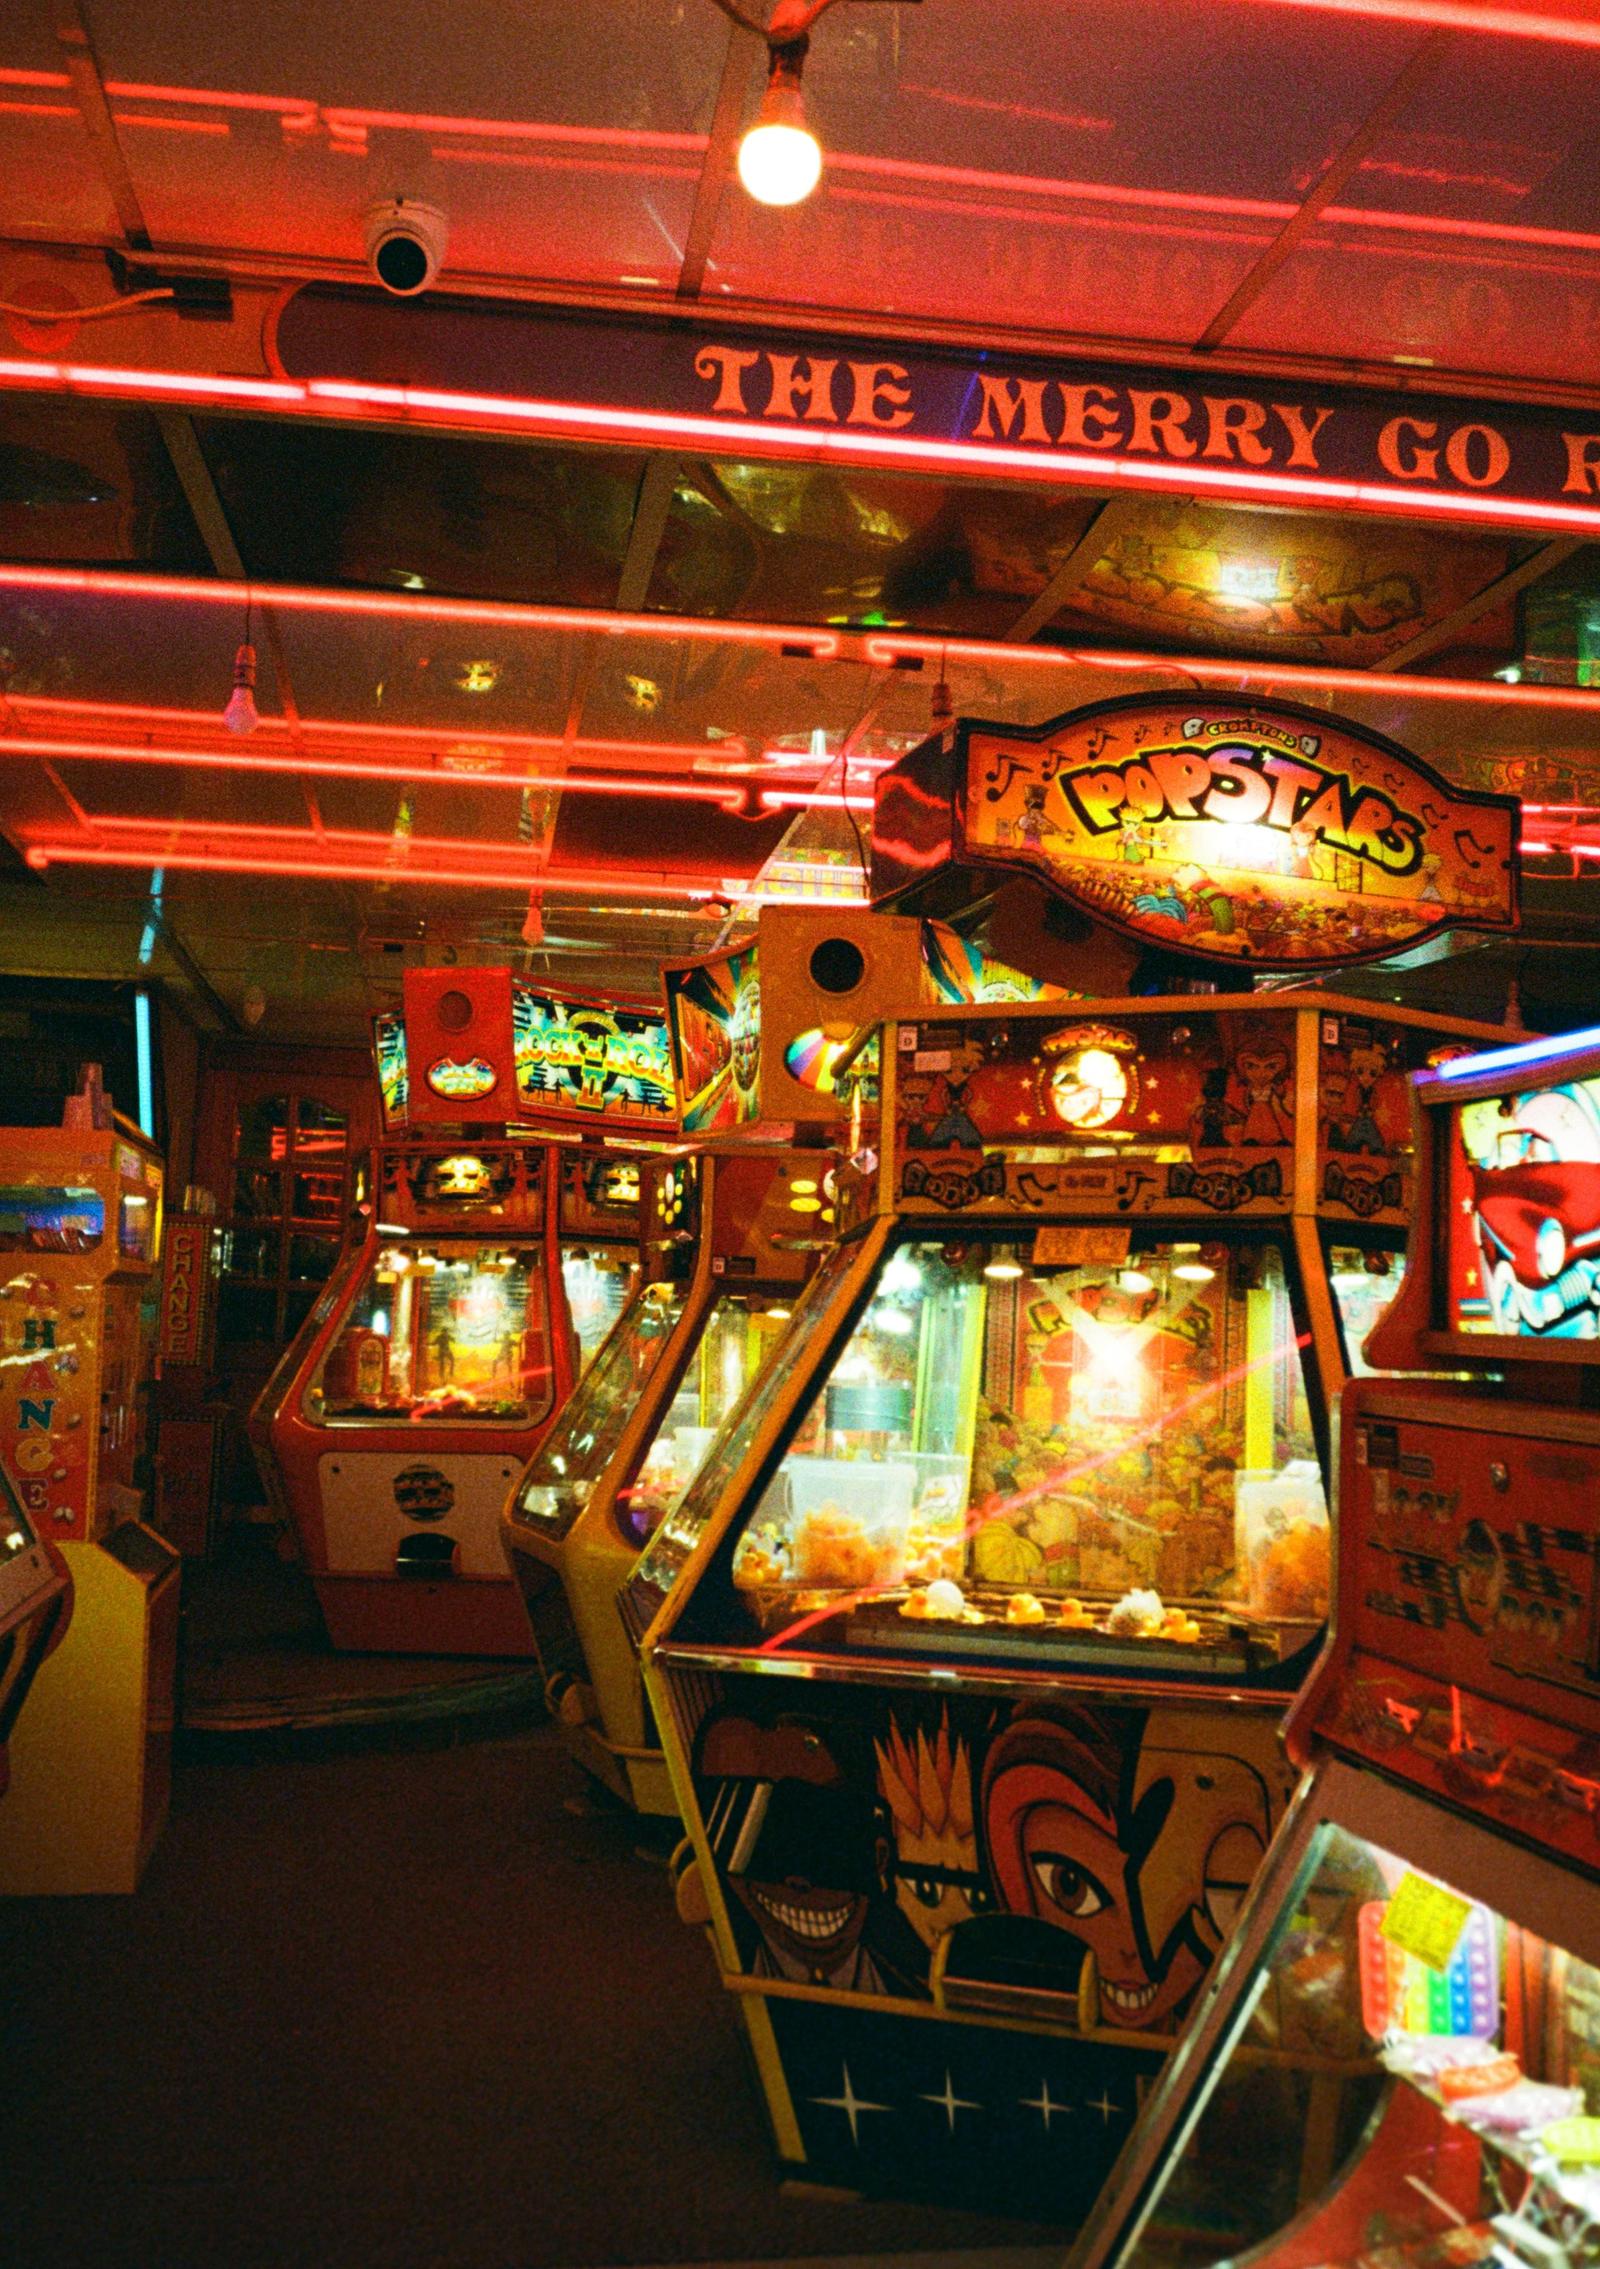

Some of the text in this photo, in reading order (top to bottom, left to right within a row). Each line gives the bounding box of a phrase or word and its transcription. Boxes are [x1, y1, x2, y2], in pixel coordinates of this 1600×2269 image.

[695, 345, 915, 428] THE
[972, 372, 1335, 469] MERRY
[1377, 416, 1511, 487] GO
[1206, 719, 1298, 748] CROMPTONS
[1061, 743, 1425, 876] POPSTARS
[168, 1234, 193, 1353] CHANGE
[17, 1278, 58, 1513] CHANGE
